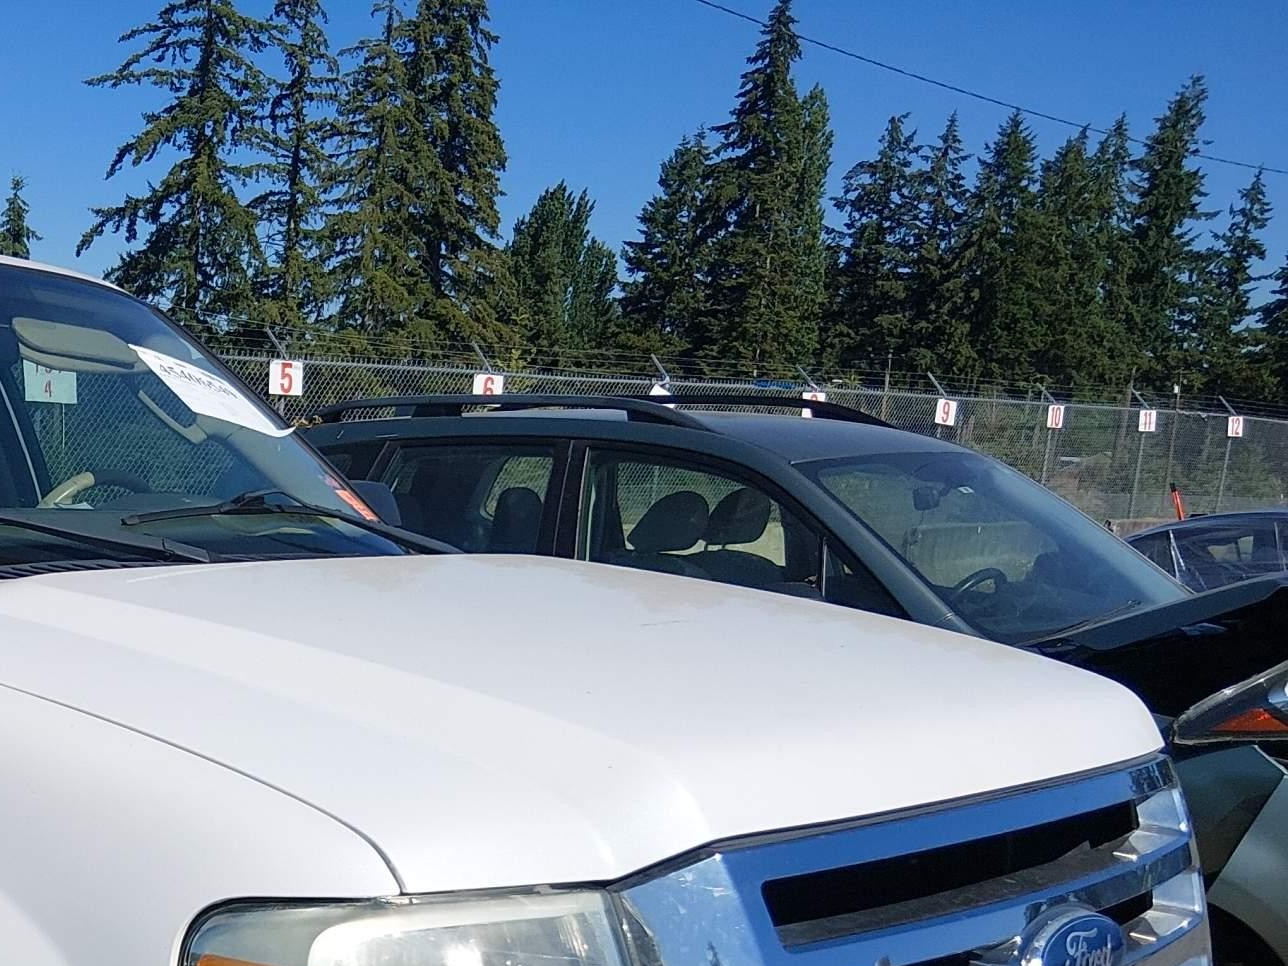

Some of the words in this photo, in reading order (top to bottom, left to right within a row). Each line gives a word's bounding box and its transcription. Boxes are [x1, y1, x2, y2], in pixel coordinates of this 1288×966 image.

[279, 362, 293, 394] 5
[482, 376, 495, 395] 6
[44, 379, 52, 398] 4
[941, 401, 951, 423] 9
[1050, 406, 1062, 427] 10
[1143, 411, 1153, 431] 11
[1230, 417, 1241, 436] 12
